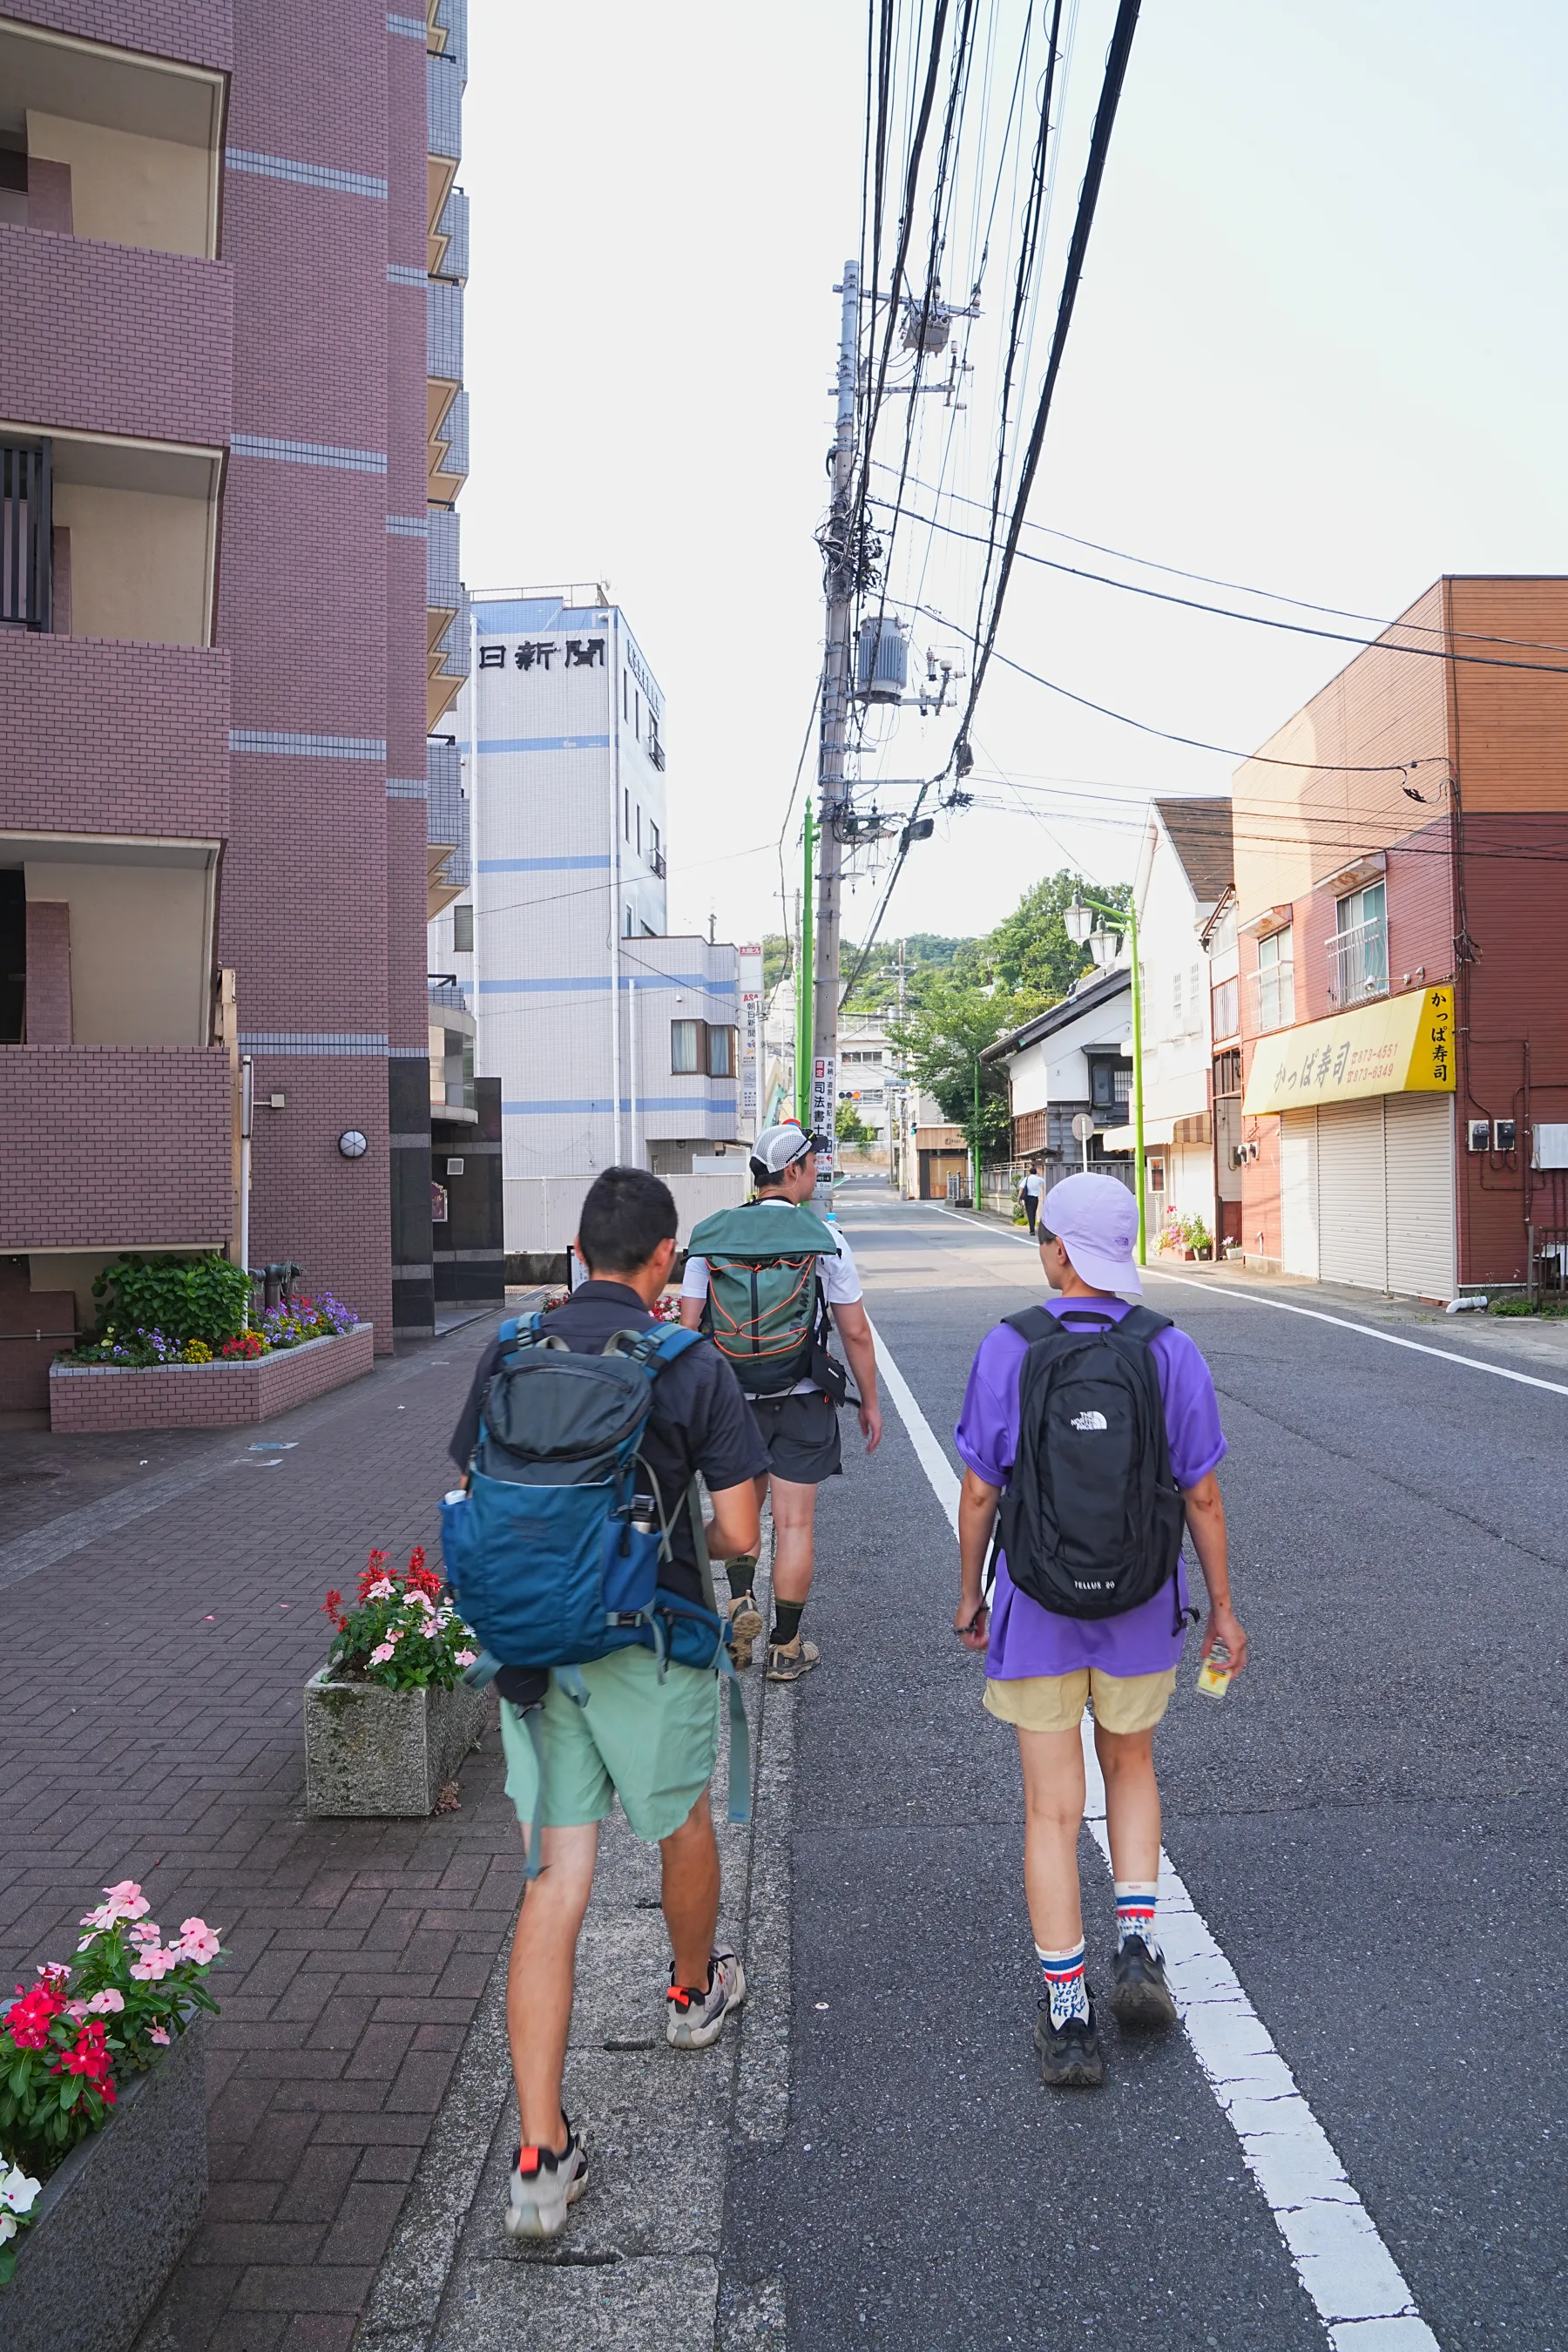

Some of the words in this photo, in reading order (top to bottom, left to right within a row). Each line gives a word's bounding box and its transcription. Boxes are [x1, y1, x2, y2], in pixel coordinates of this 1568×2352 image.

[479, 638, 605, 672] 日新聞
[747, 1002, 756, 1037] 朝日新聞
[1357, 1043, 1398, 1064] 873-4551
[1431, 992, 1449, 1082] かっぱ寿司
[1274, 1041, 1351, 1093] かっぱ寿司
[1353, 1063, 1394, 1083] 873-6349
[814, 1081, 825, 1137] 司法書士
[1074, 1580, 1102, 1590] TELLUS
